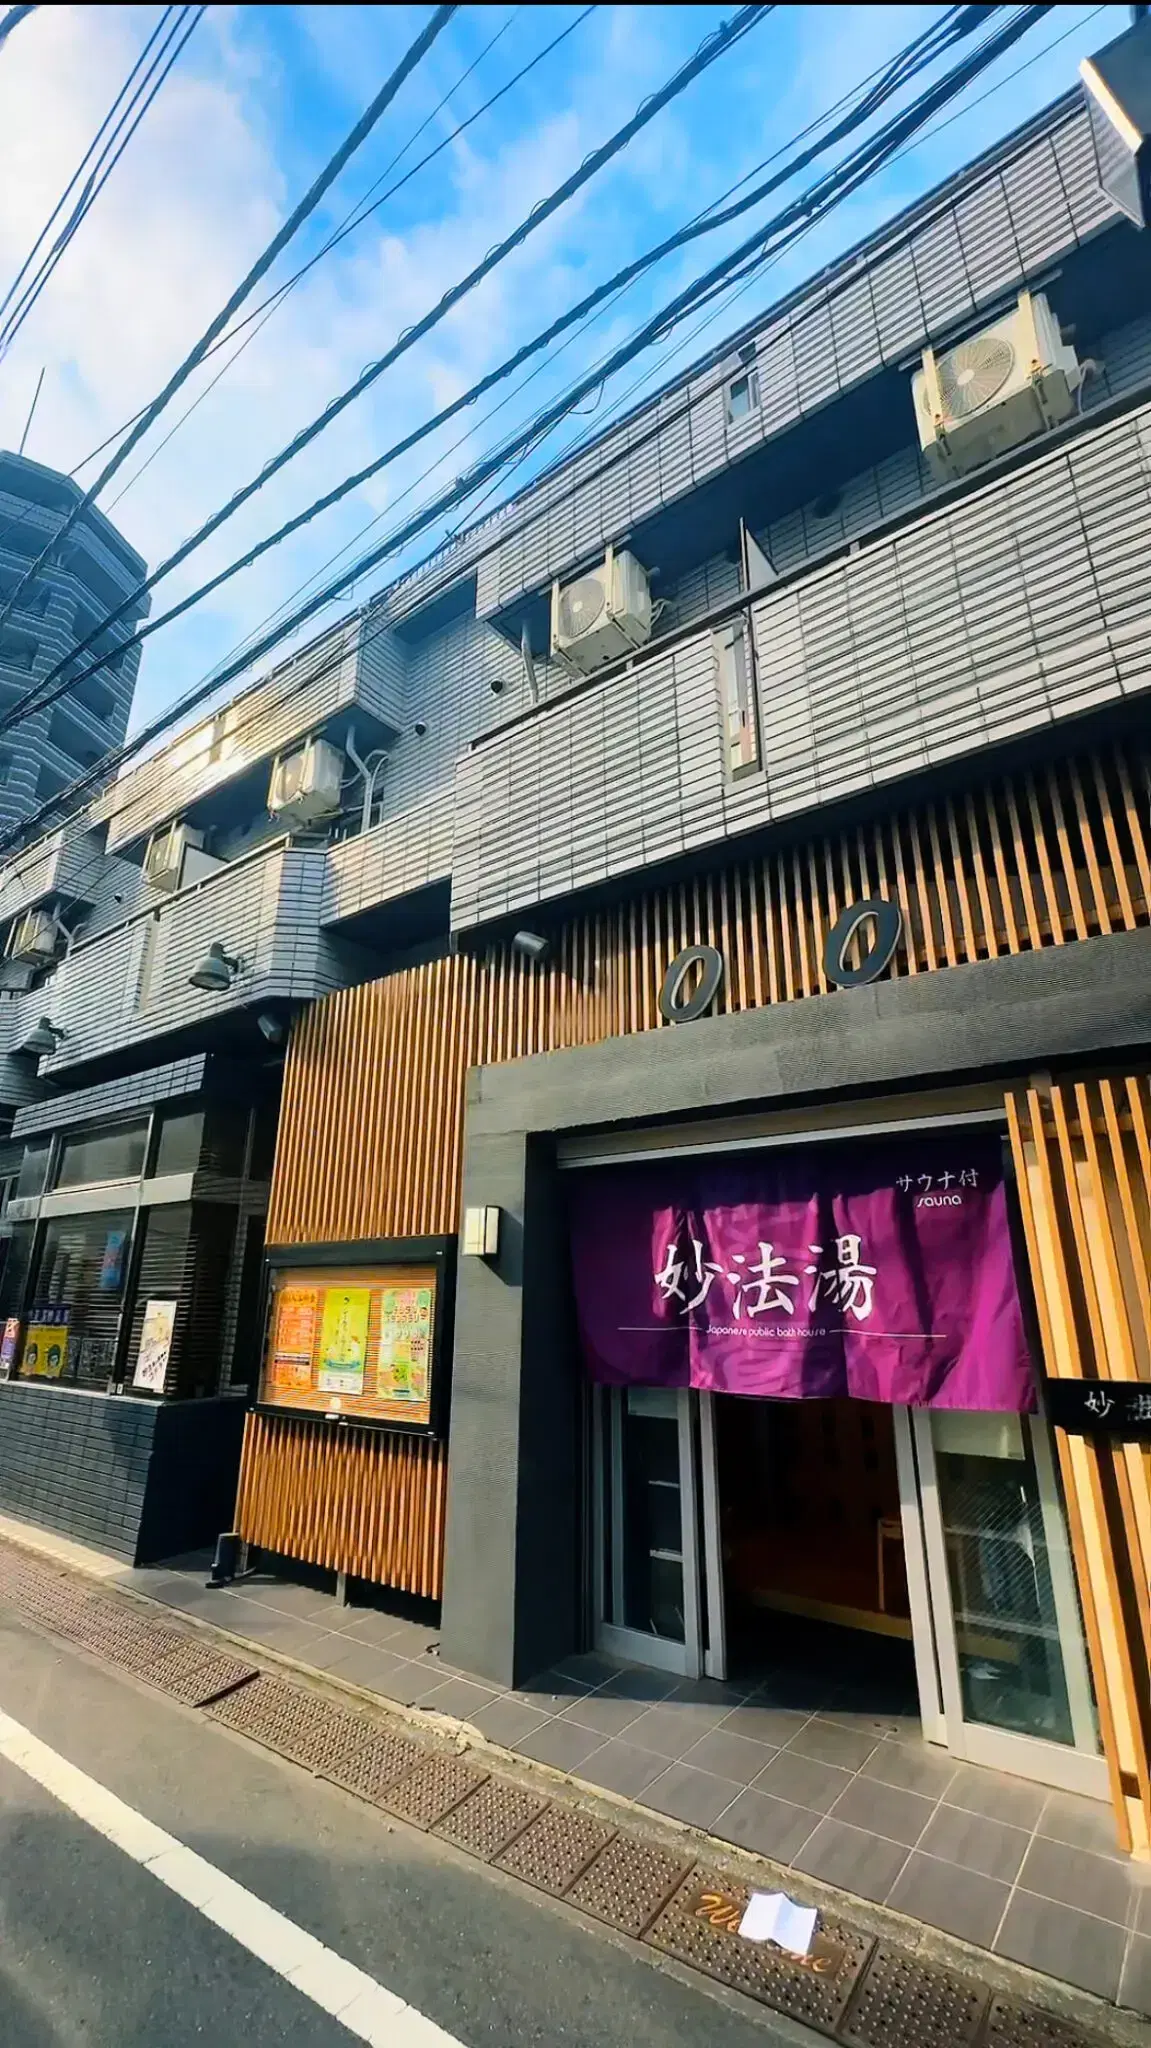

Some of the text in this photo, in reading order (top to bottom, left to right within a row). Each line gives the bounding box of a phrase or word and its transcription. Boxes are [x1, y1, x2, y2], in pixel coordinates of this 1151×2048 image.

[895, 1168, 979, 1193] サウナ付
[917, 1194, 962, 1208] sauna
[654, 1233, 878, 1322] 妙法湯
[706, 1324, 747, 1336] Japanese
[748, 1326, 775, 1338] public
